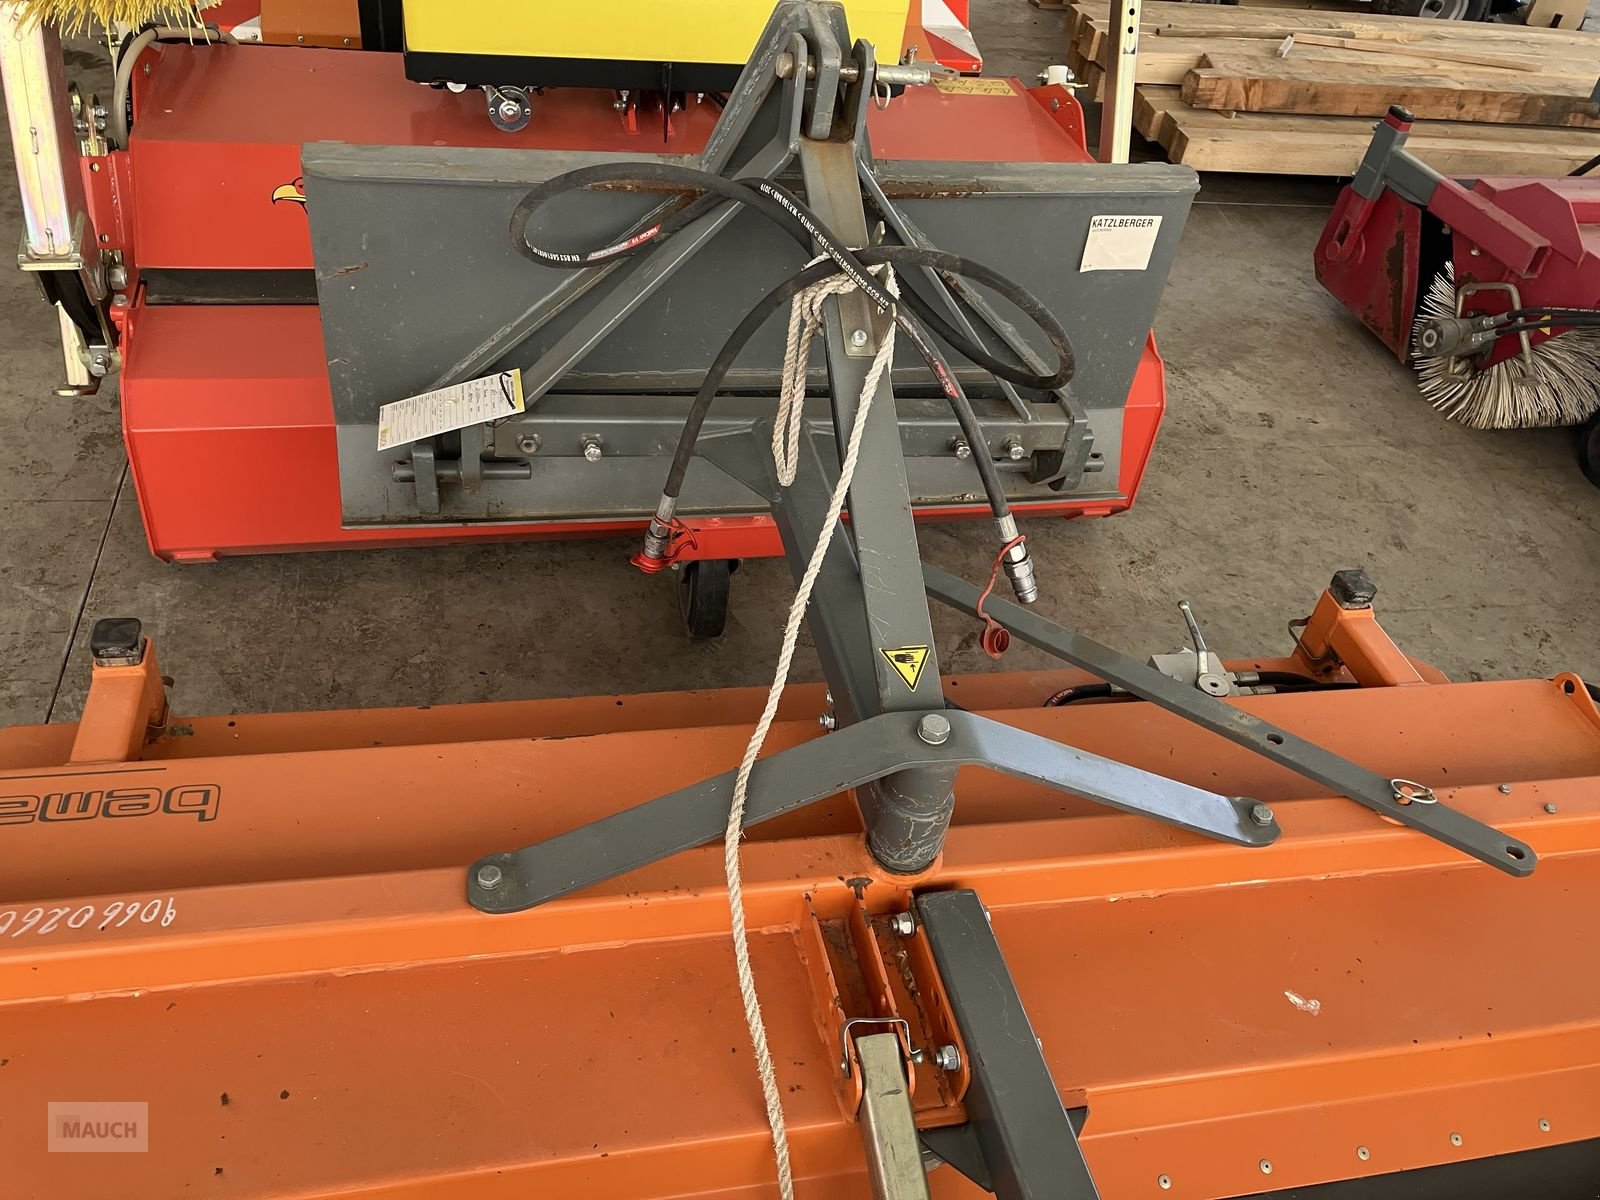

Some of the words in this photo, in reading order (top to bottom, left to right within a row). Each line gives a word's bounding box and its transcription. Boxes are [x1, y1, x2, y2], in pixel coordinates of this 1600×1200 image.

[1092, 218, 1153, 228] KATZLBERGER
[866, 286, 880, 300] 853
[880, 297, 889, 309] EN
